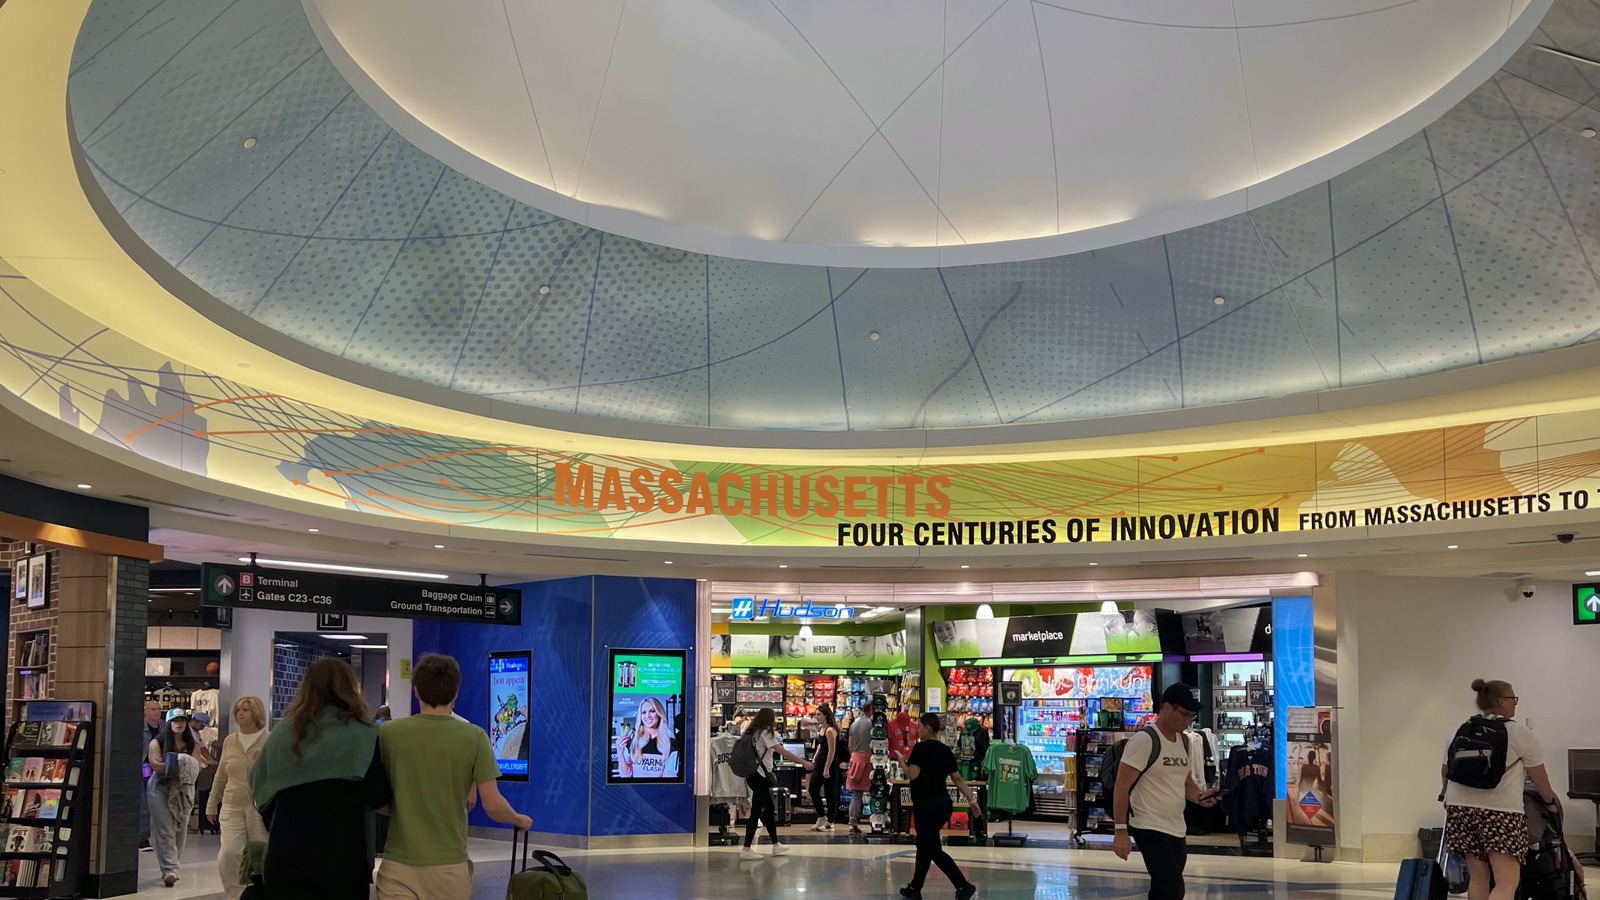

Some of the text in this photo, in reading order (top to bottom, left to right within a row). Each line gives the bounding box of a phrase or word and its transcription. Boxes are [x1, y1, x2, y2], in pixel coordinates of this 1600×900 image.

[555, 462, 952, 518] MASSACHUSETTS
[1299, 490, 1588, 530] FROM MASSACHUSETTS TO
[837, 507, 1280, 547] FOUR CENTURIES OF INNOVATION
[242, 574, 298, 588] B Terminal
[256, 591, 332, 605] Gates C23-C36
[421, 589, 482, 602] Baggage Claim
[390, 600, 482, 615] Ground Transportation
[758, 598, 855, 618] Hudson
[1012, 630, 1064, 643] marketplace
[812, 645, 836, 654] HERSHEY'S
[494, 676, 505, 685] bon
[717, 752, 732, 765] BOS
[1163, 756, 1188, 767] 2XU
